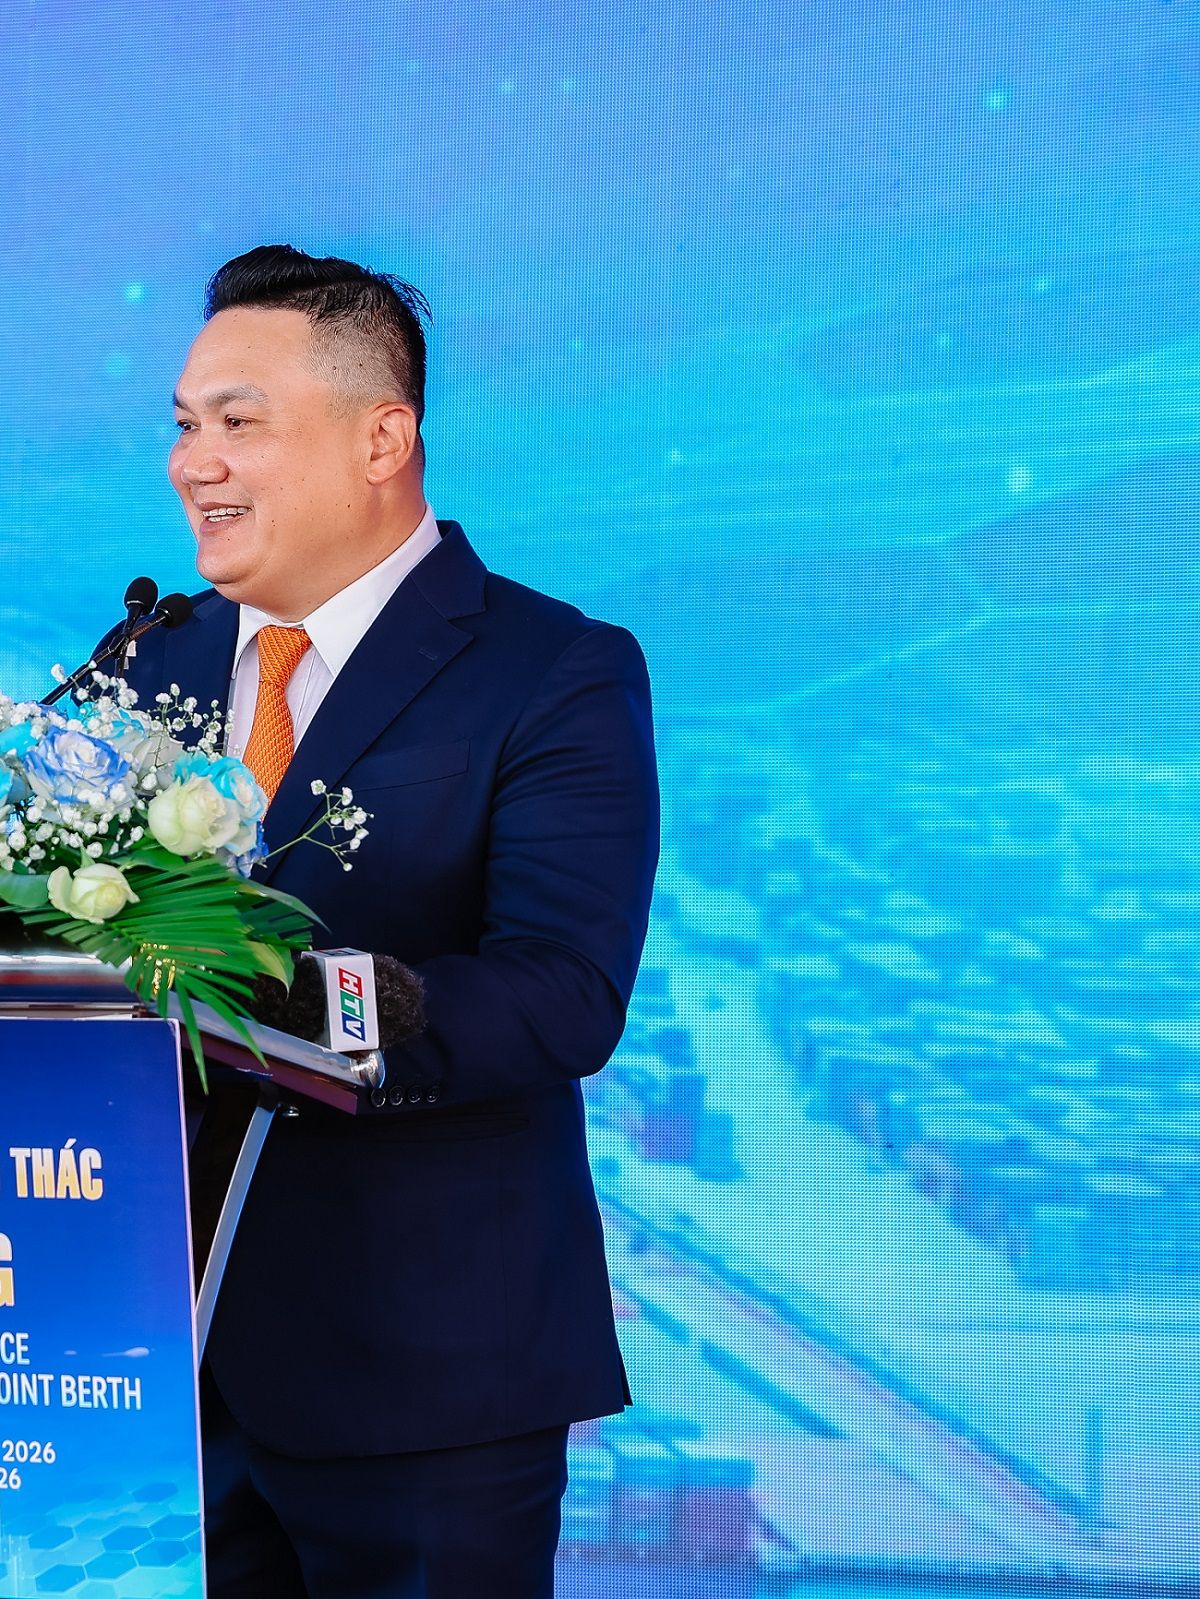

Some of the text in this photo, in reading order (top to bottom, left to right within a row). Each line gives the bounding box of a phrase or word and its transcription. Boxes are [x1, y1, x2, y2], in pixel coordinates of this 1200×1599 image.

[339, 969, 365, 1041] HTV
[10, 1139, 103, 1200] THÁC
[61, 1375, 140, 1409] BERTH
[2, 1440, 55, 1463] 2026
